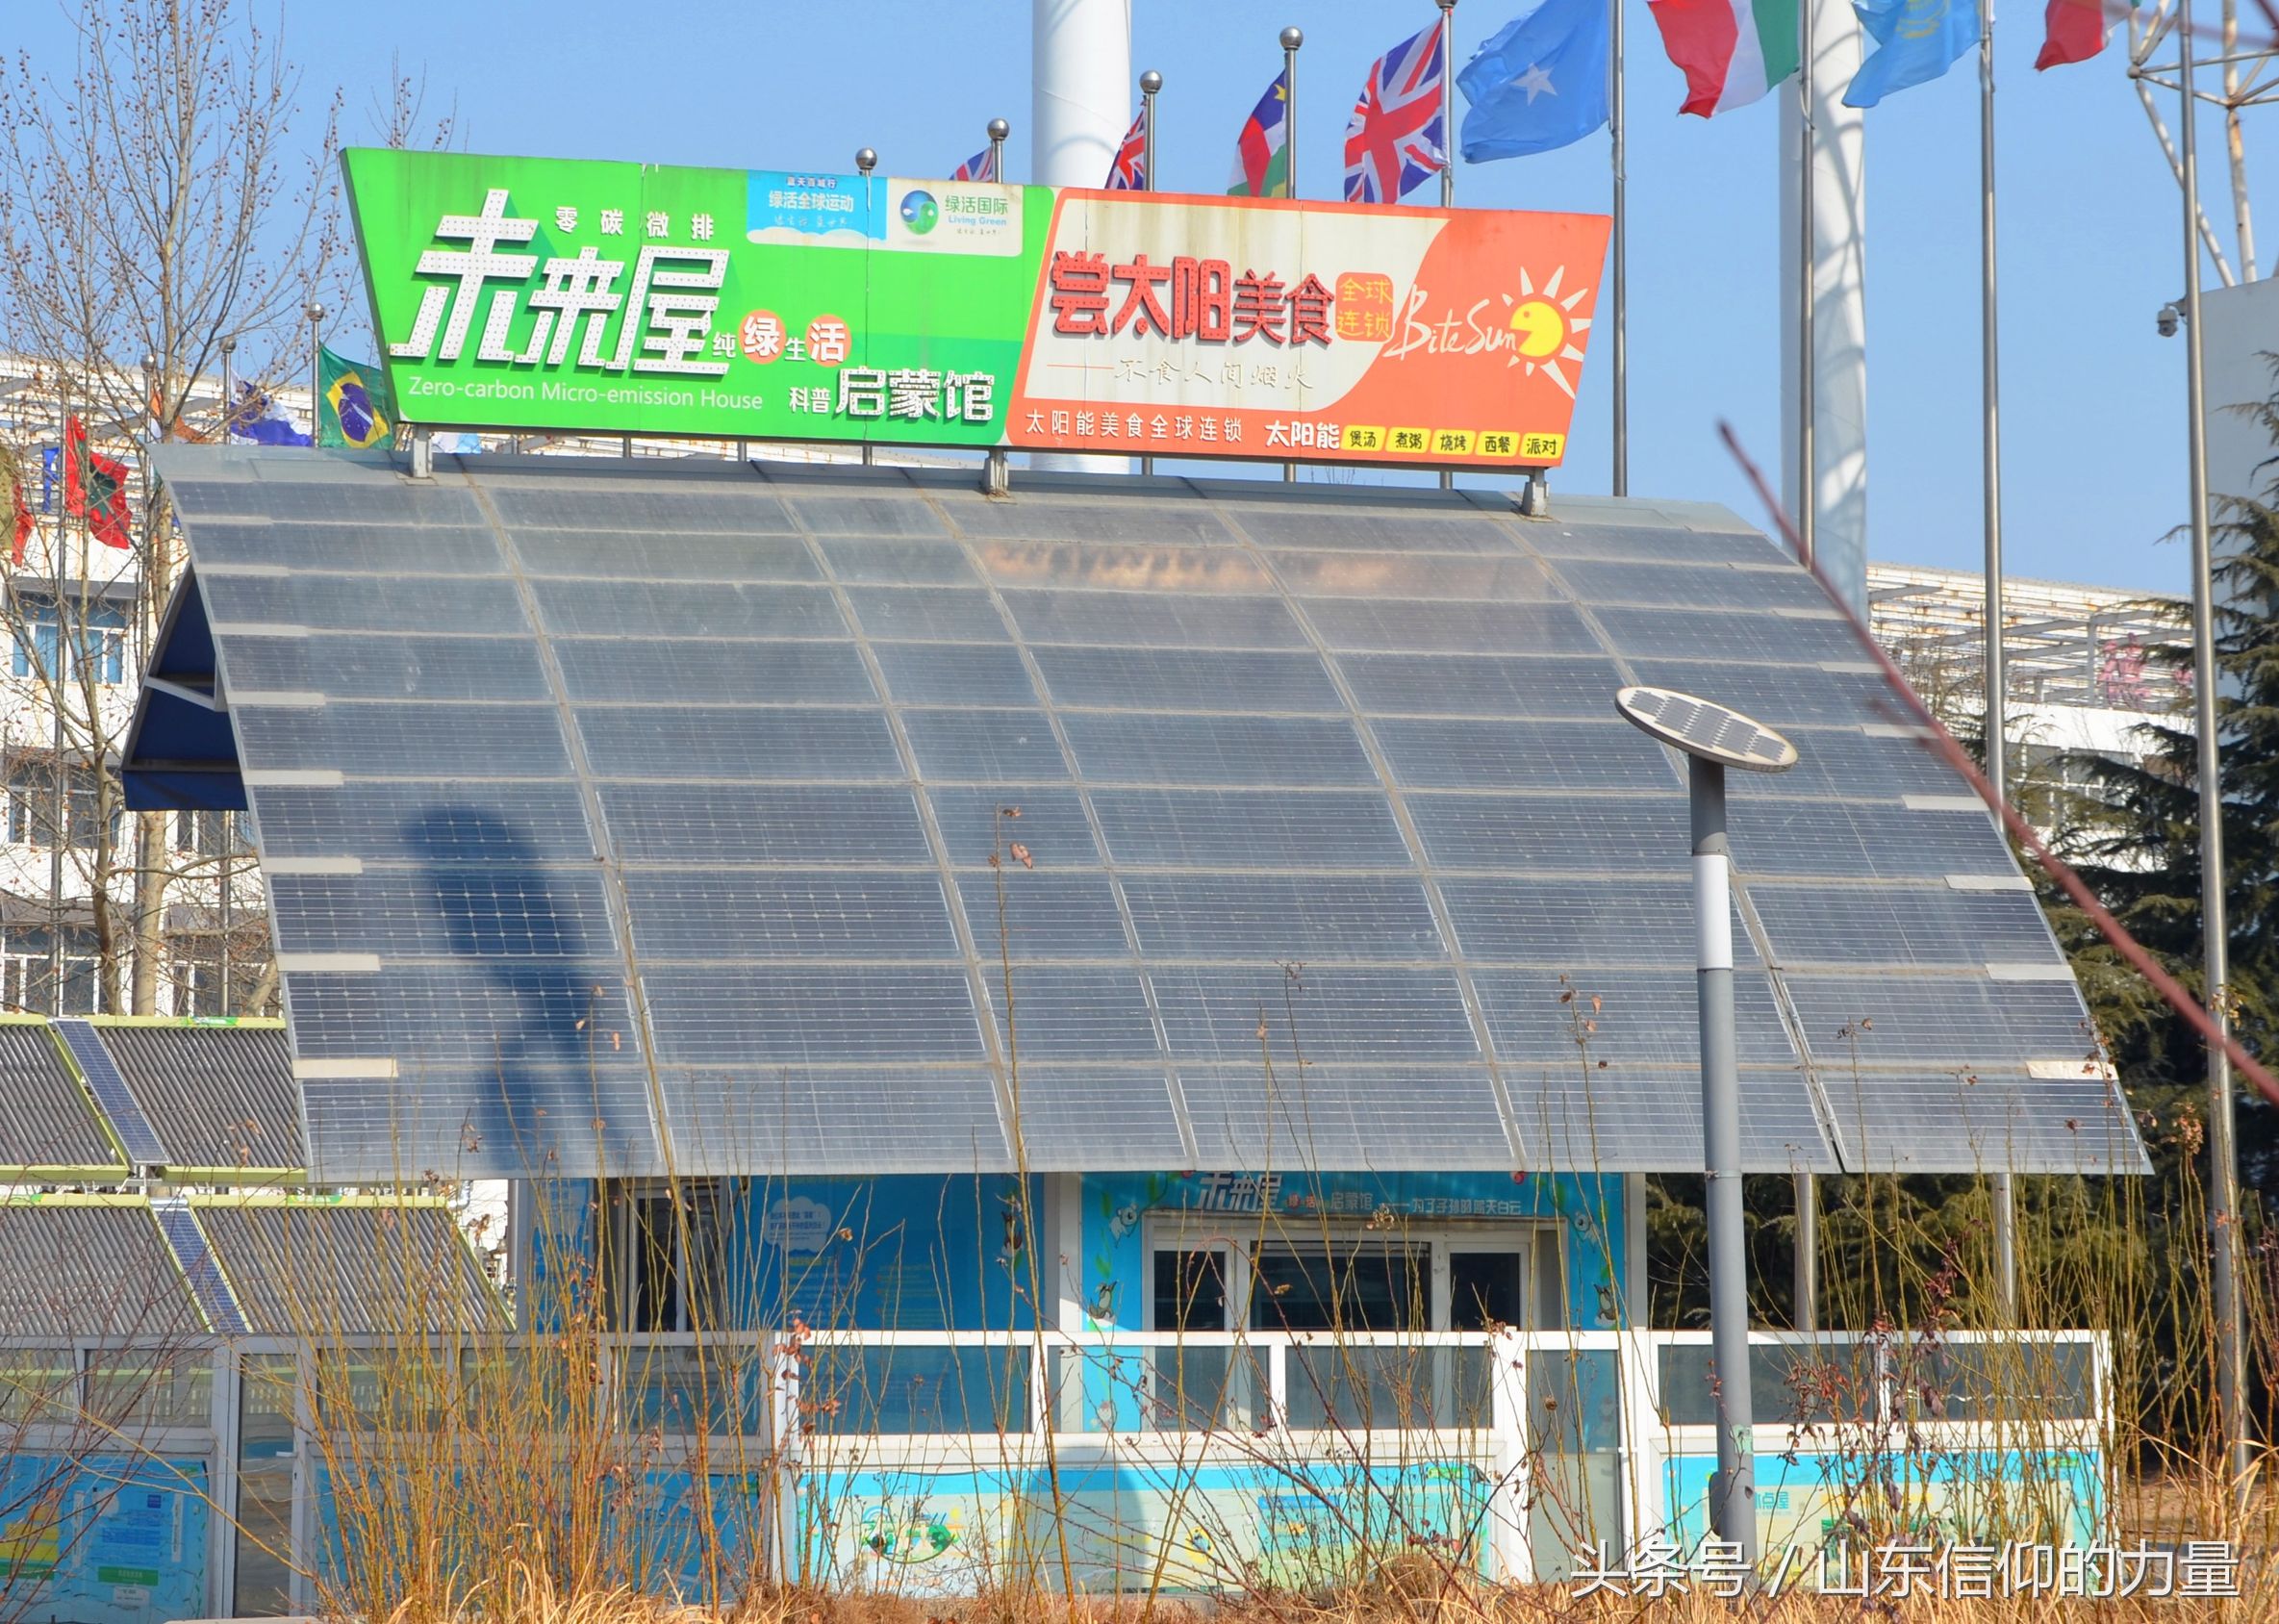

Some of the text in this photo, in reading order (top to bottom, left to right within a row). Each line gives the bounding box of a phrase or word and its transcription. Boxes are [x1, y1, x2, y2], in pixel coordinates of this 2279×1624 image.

[769, 190, 854, 213] 绿活全球运动
[945, 195, 1008, 216] 绿活国际
[555, 206, 714, 241] 零碳微排
[949, 215, 1007, 227] Living Green
[389, 189, 730, 374] 未来屋
[1051, 251, 1335, 345] 尝太阳美食
[1338, 276, 1393, 305] 全球
[712, 316, 847, 364] 纯绿生活
[1335, 310, 1392, 339] 连锁
[408, 376, 764, 411] Zero-carbon Micro-emission House
[788, 365, 997, 421] 科普 启蒙馆
[1026, 409, 1243, 444] 太阳能美食全球连锁
[1265, 419, 1557, 456] 太阳能 煲汤 煮粥 烧烤 西餐 派对
[1196, 1171, 1283, 1212] 未来屋
